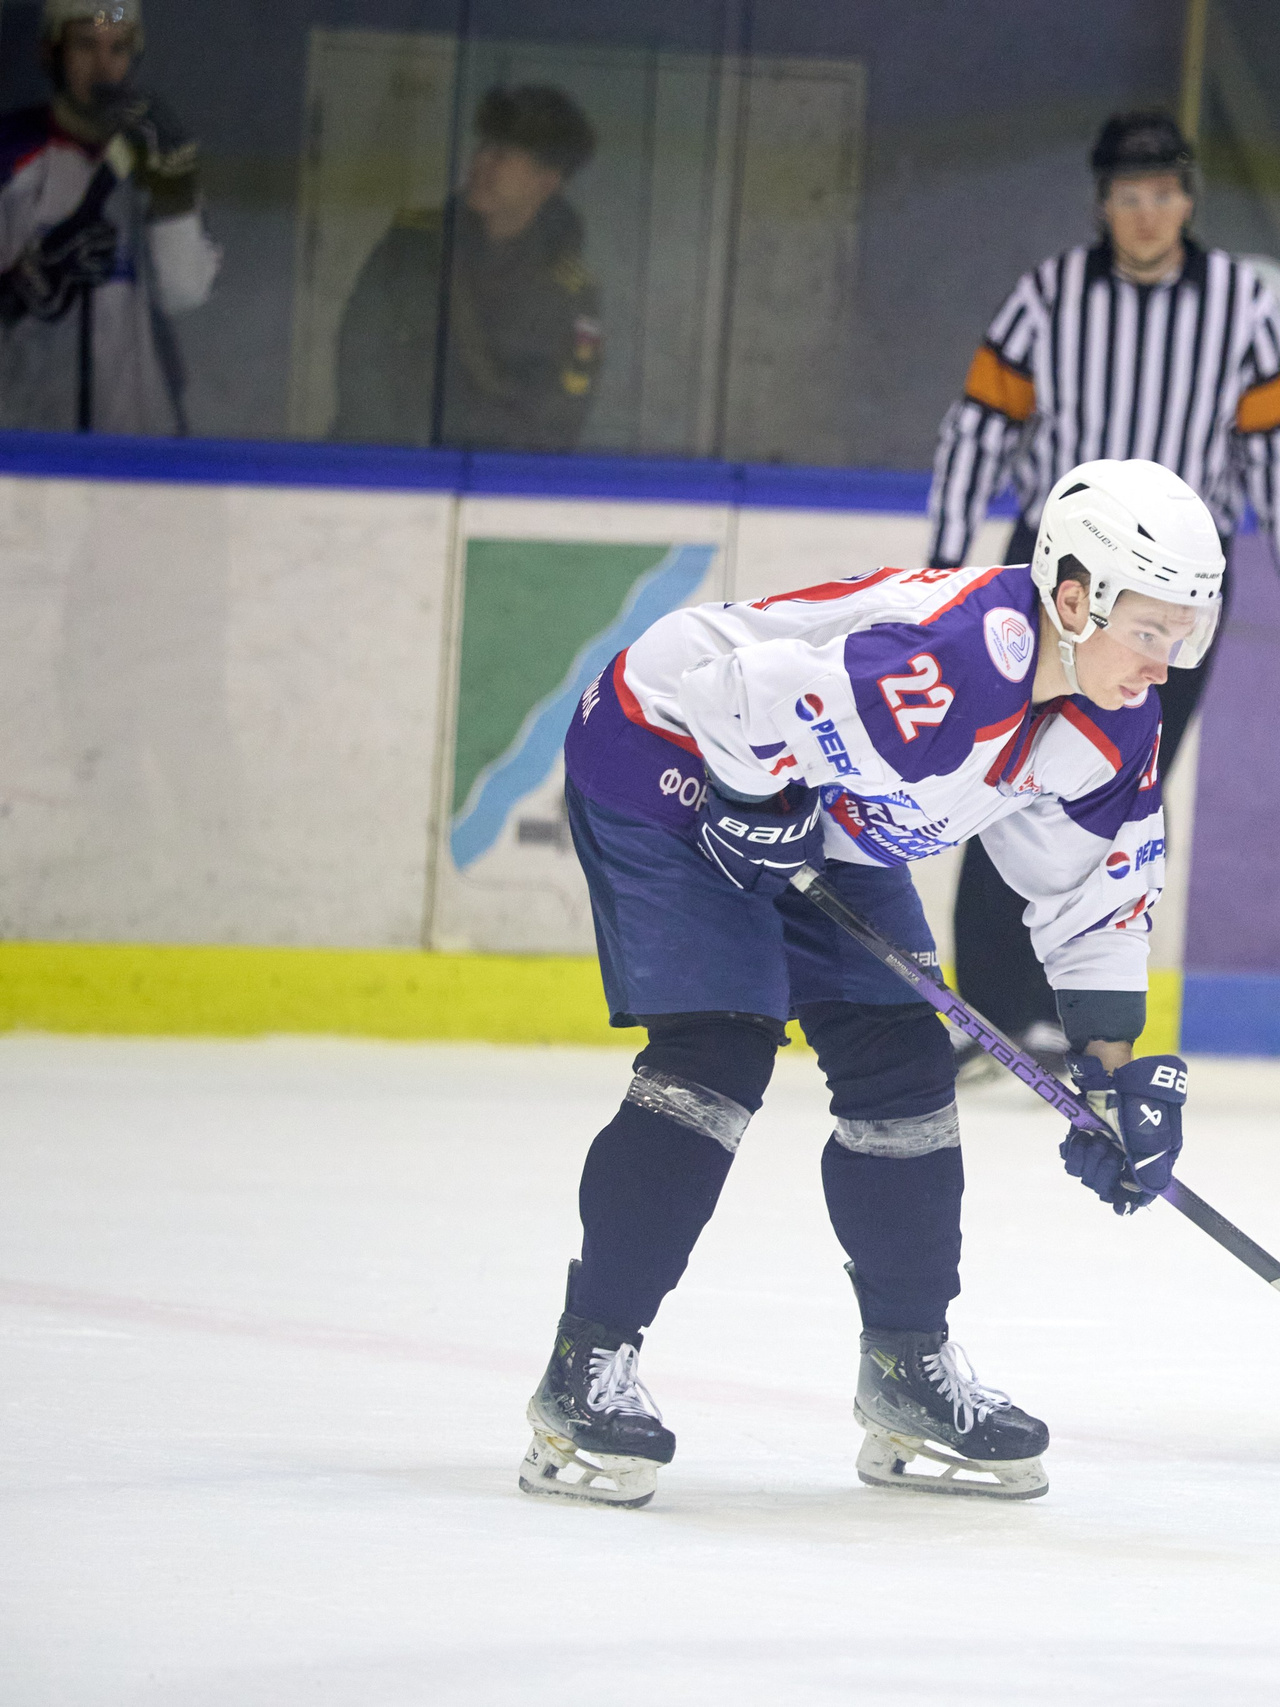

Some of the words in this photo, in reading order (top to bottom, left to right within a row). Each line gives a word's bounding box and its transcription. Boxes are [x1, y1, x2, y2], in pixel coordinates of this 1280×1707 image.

[877, 652, 956, 744] 22
[811, 718, 862, 778] PEP
[1135, 838, 1165, 872] PEP
